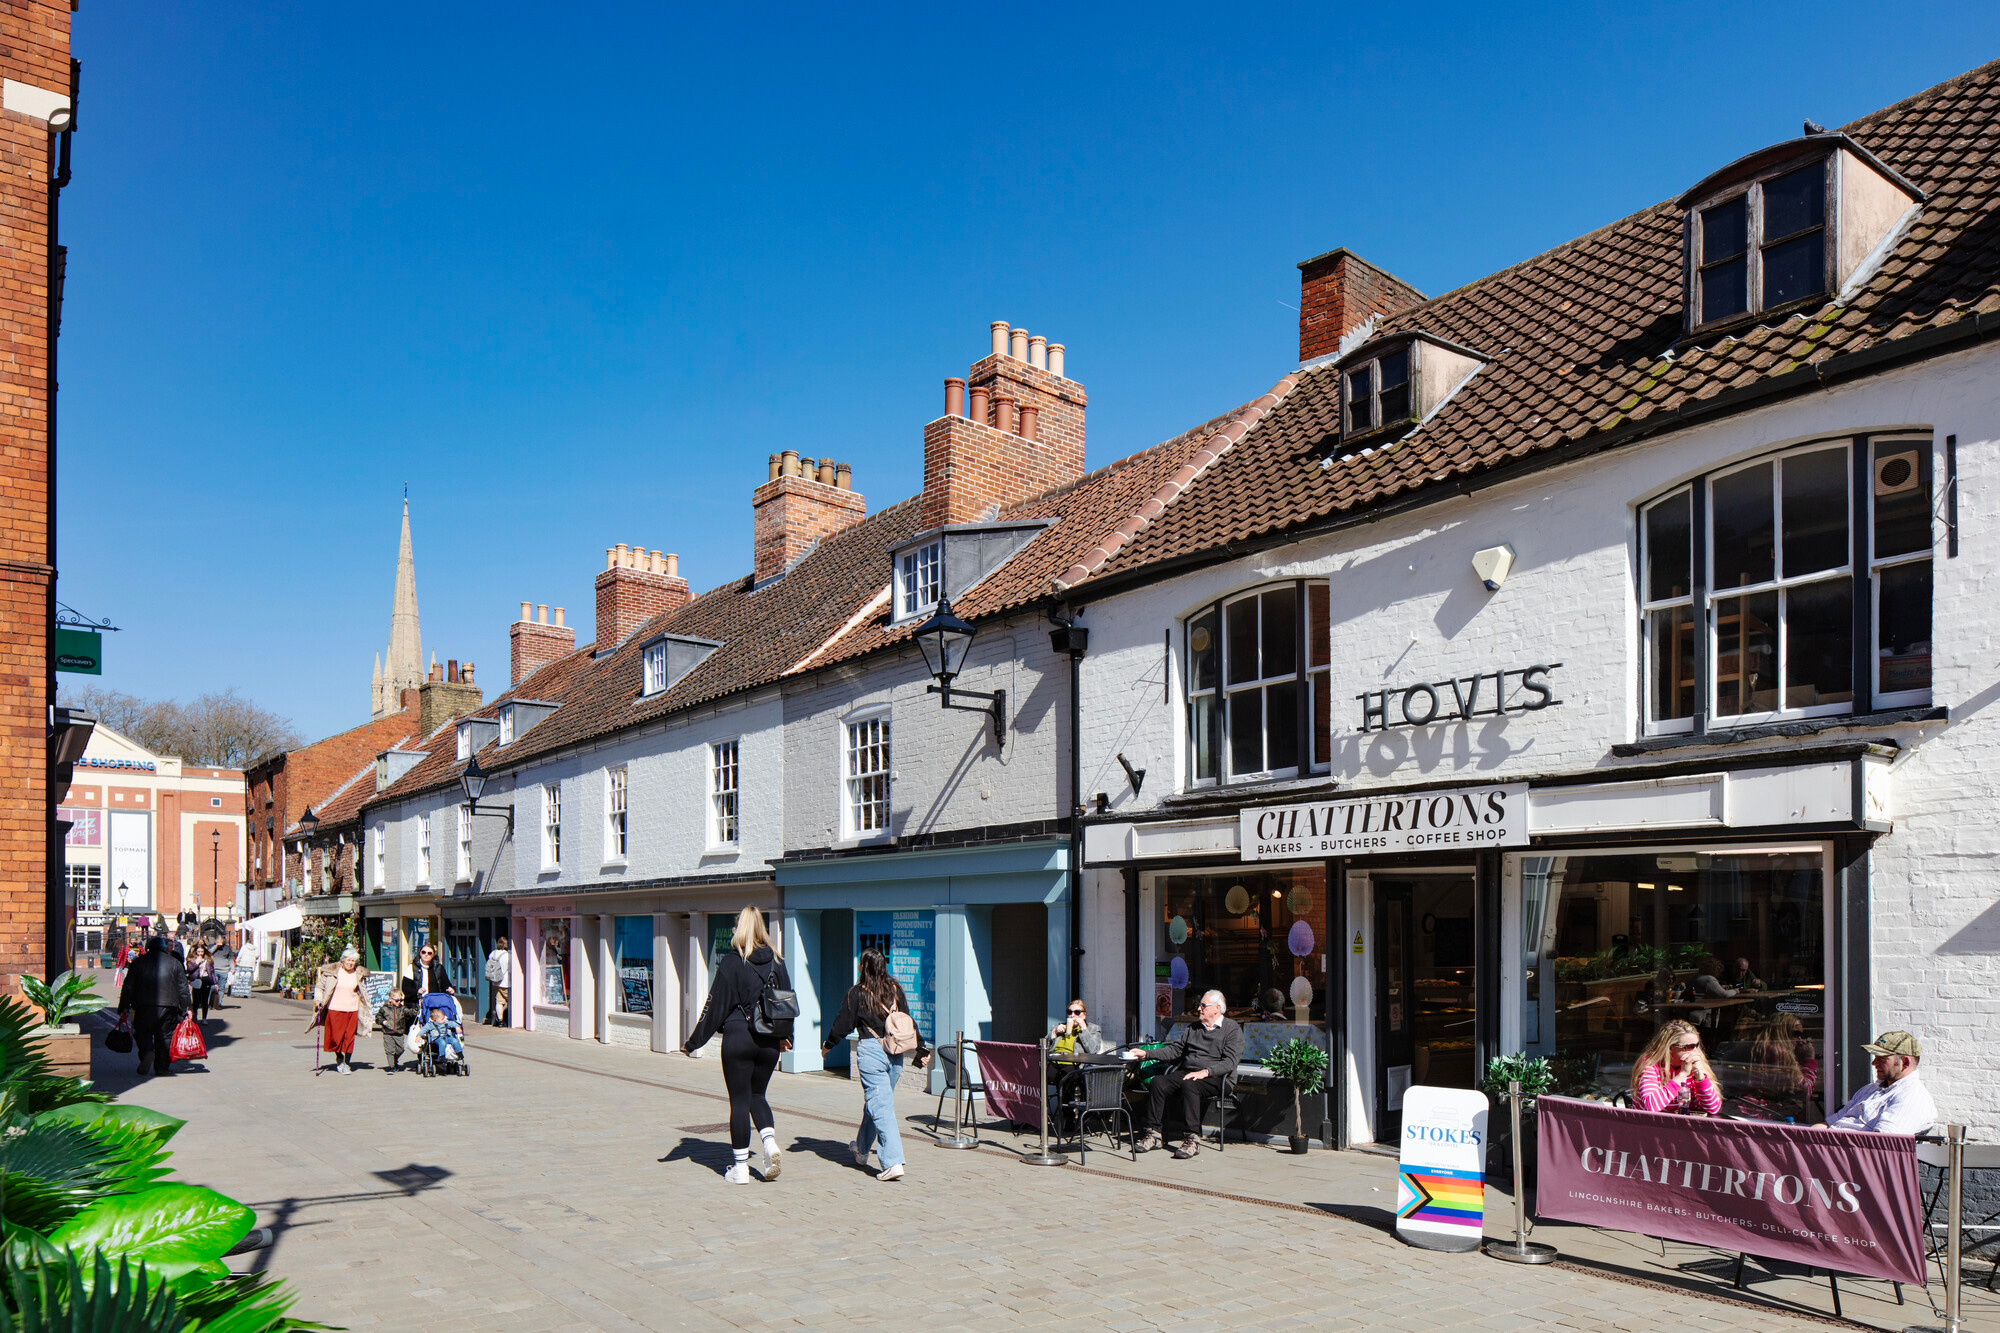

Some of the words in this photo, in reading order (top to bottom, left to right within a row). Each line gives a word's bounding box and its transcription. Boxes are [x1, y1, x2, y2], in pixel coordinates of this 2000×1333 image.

[59, 656, 93, 666] Specsavers
[1363, 663, 1551, 733] HOVIS
[90, 757, 155, 770] SHOPPING
[1256, 790, 1507, 841] CHATTERTONS
[1257, 842, 1302, 854] BAKERS
[1321, 837, 1387, 850] BUTCHERS
[1406, 831, 1460, 845] COFFEE
[1466, 829, 1507, 842] SHOP
[893, 911, 919, 920] FASHION
[893, 920, 933, 929] COMMUNITY
[893, 929, 914, 938] PUBLIC
[893, 938, 925, 947] TOGETHER
[893, 947, 909, 955] CIVIC
[893, 956, 920, 965] CULTURE
[893, 965, 919, 974] HISTORY
[913, 1010, 932, 1020] PRIDE
[1406, 1124, 1482, 1146] STOKES
[1430, 1168, 1453, 1176] EVERYONE
[1579, 1145, 1862, 1214] CHATTERTONS
[1568, 1190, 1643, 1210] LINCOLNSHIRE
[1843, 1236, 1877, 1248] SHOP
